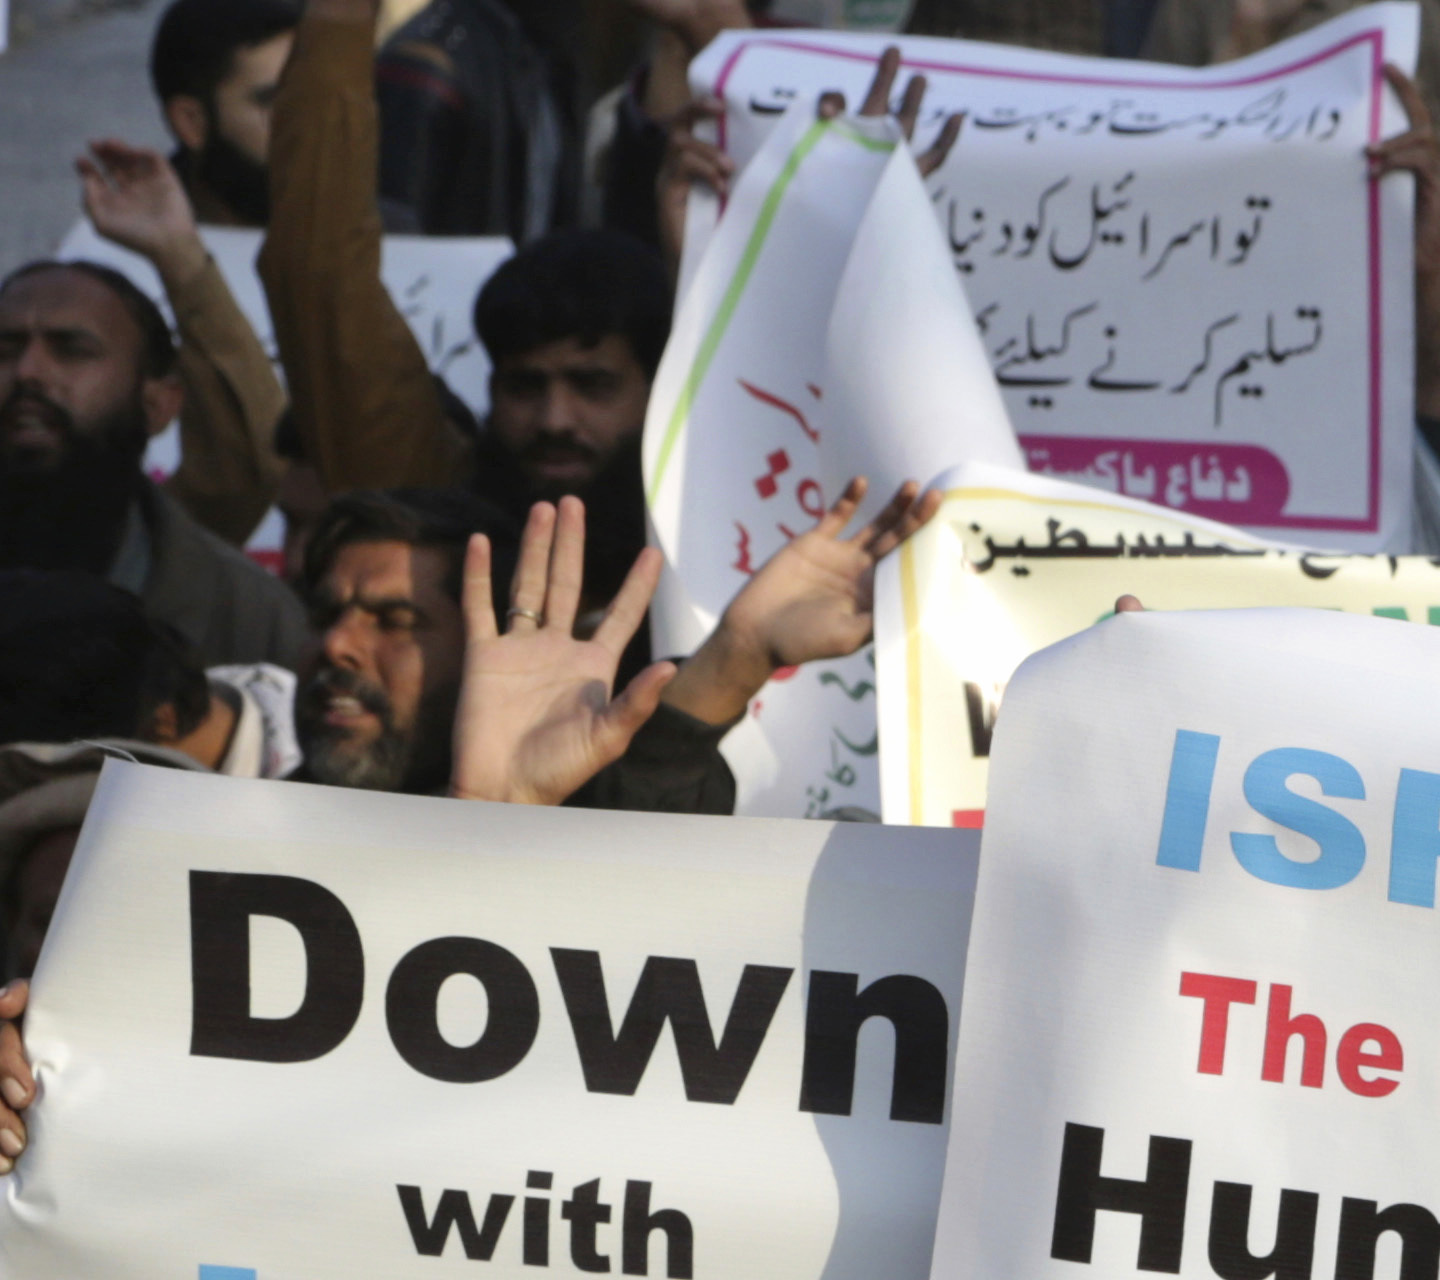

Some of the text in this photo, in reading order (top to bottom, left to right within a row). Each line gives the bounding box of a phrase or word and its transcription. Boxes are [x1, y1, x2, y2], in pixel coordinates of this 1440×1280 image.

[1048, 171, 1220, 281] اسرائیل
[1233, 196, 1274, 265] تو
[1212, 306, 1324, 428] تسلیم
[1166, 456, 1252, 508] دفاع
[186, 867, 952, 1128] Down
[1176, 968, 1407, 1099] The
